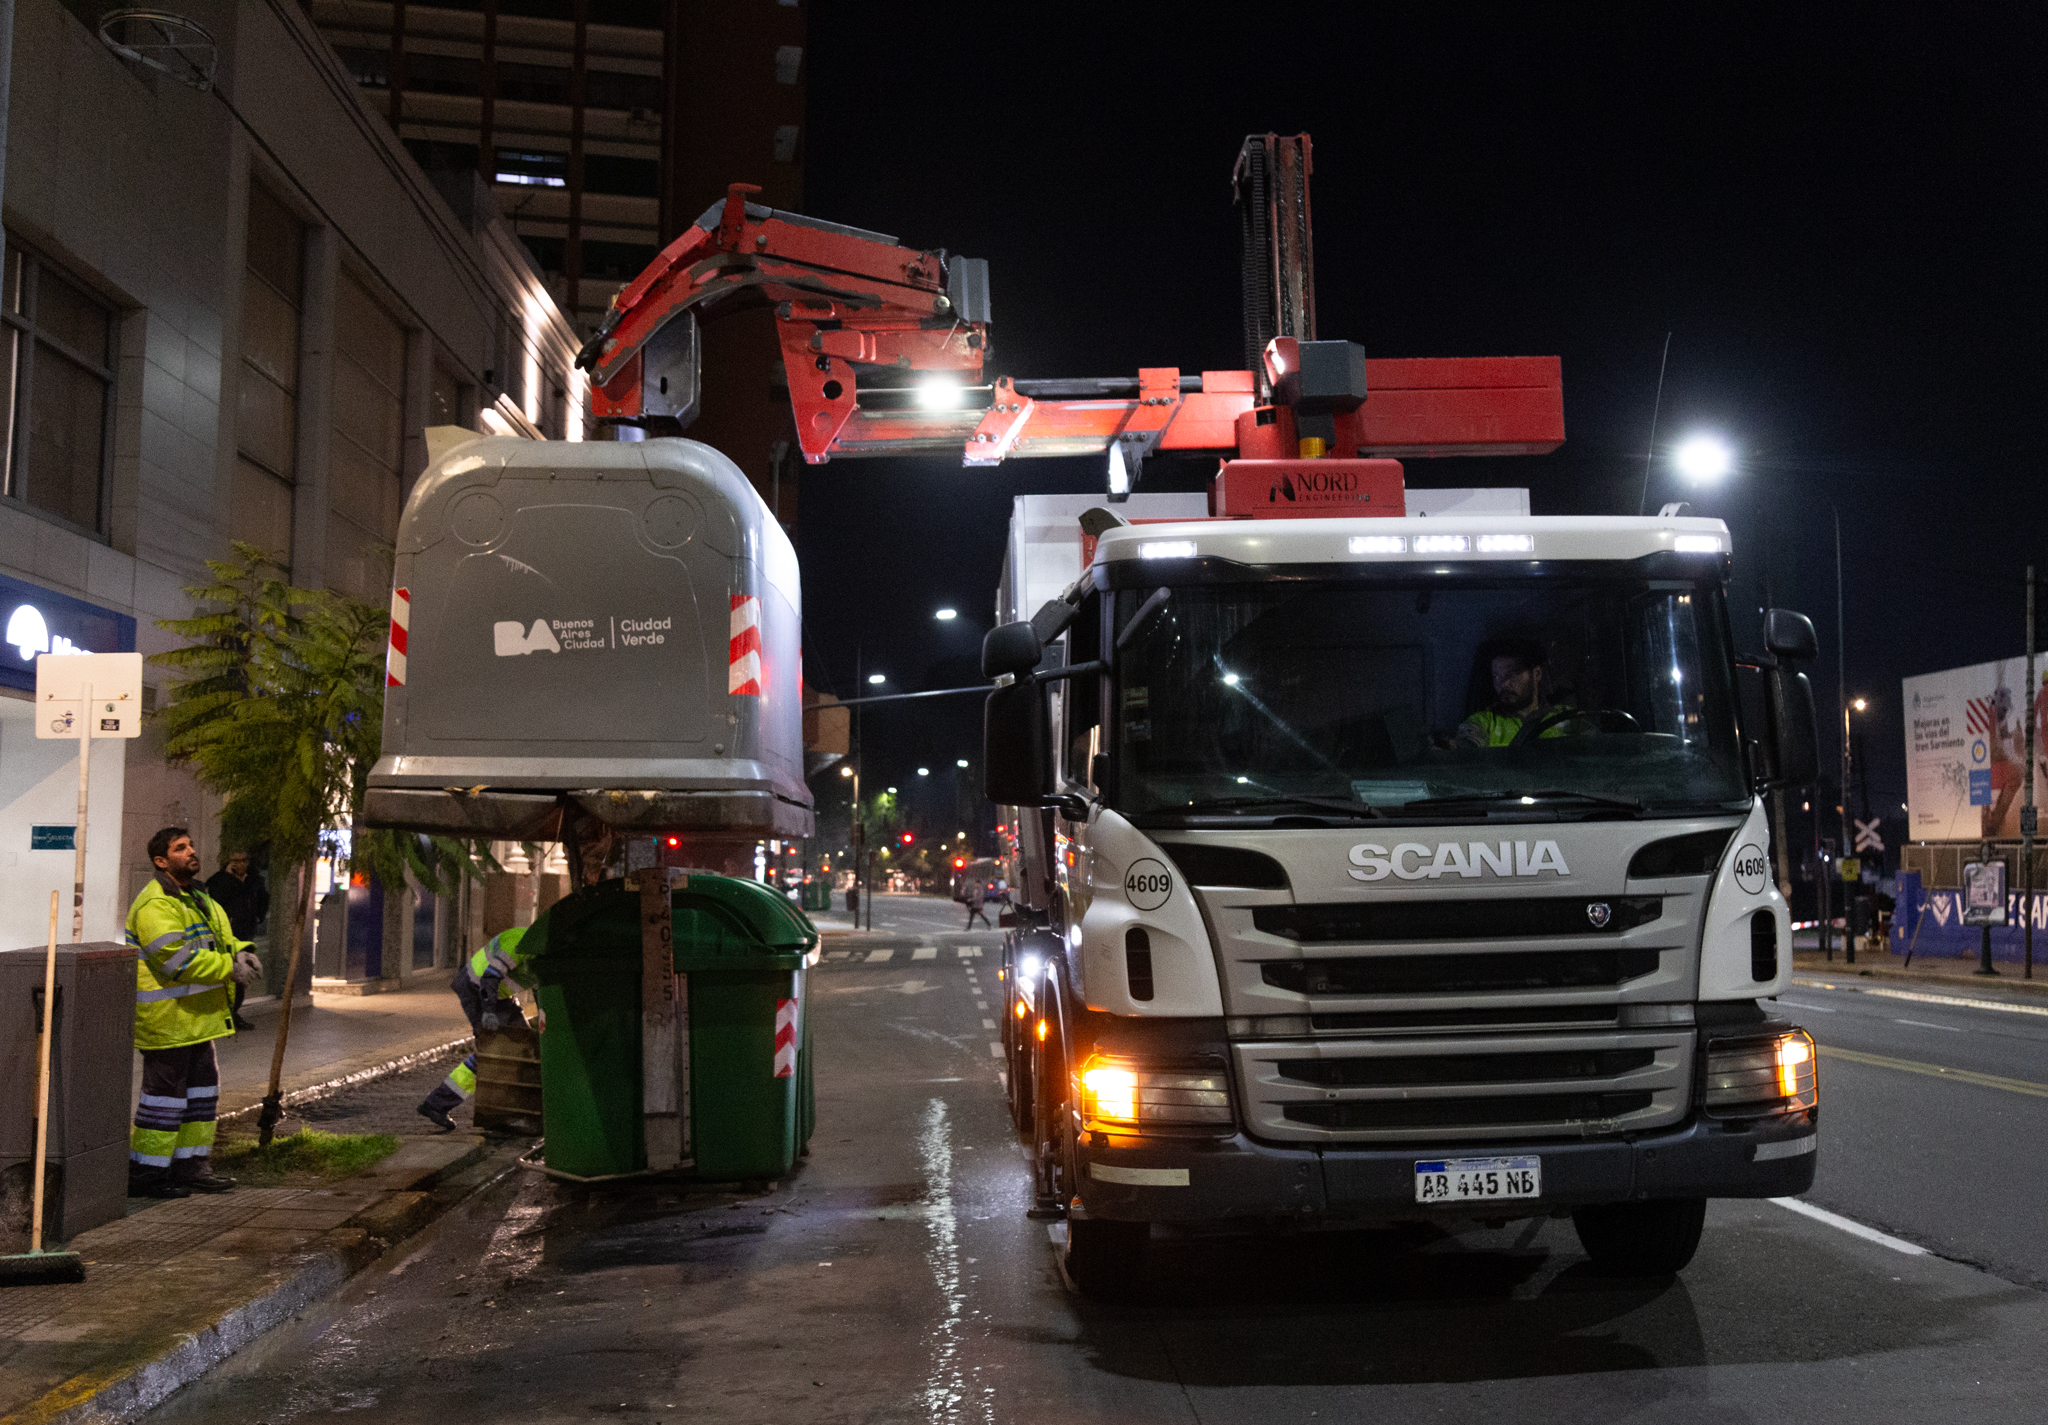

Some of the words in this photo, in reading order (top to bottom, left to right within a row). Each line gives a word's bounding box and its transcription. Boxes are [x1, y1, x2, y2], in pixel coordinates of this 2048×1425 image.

[1298, 472, 1358, 492] NORD
[552, 619, 594, 630] Buenos
[620, 616, 672, 632] Ciudad
[494, 618, 561, 657] BA
[560, 629, 592, 640] Aires
[564, 637, 605, 650] Ciudad
[621, 632, 665, 646] Verde
[1347, 840, 1571, 882] SCANIA
[1736, 858, 1764, 877] 4609
[1127, 874, 1170, 892] 4609
[1422, 1174, 1450, 1198] AB
[1458, 1172, 1499, 1196] 445
[1506, 1170, 1535, 1194] NB
